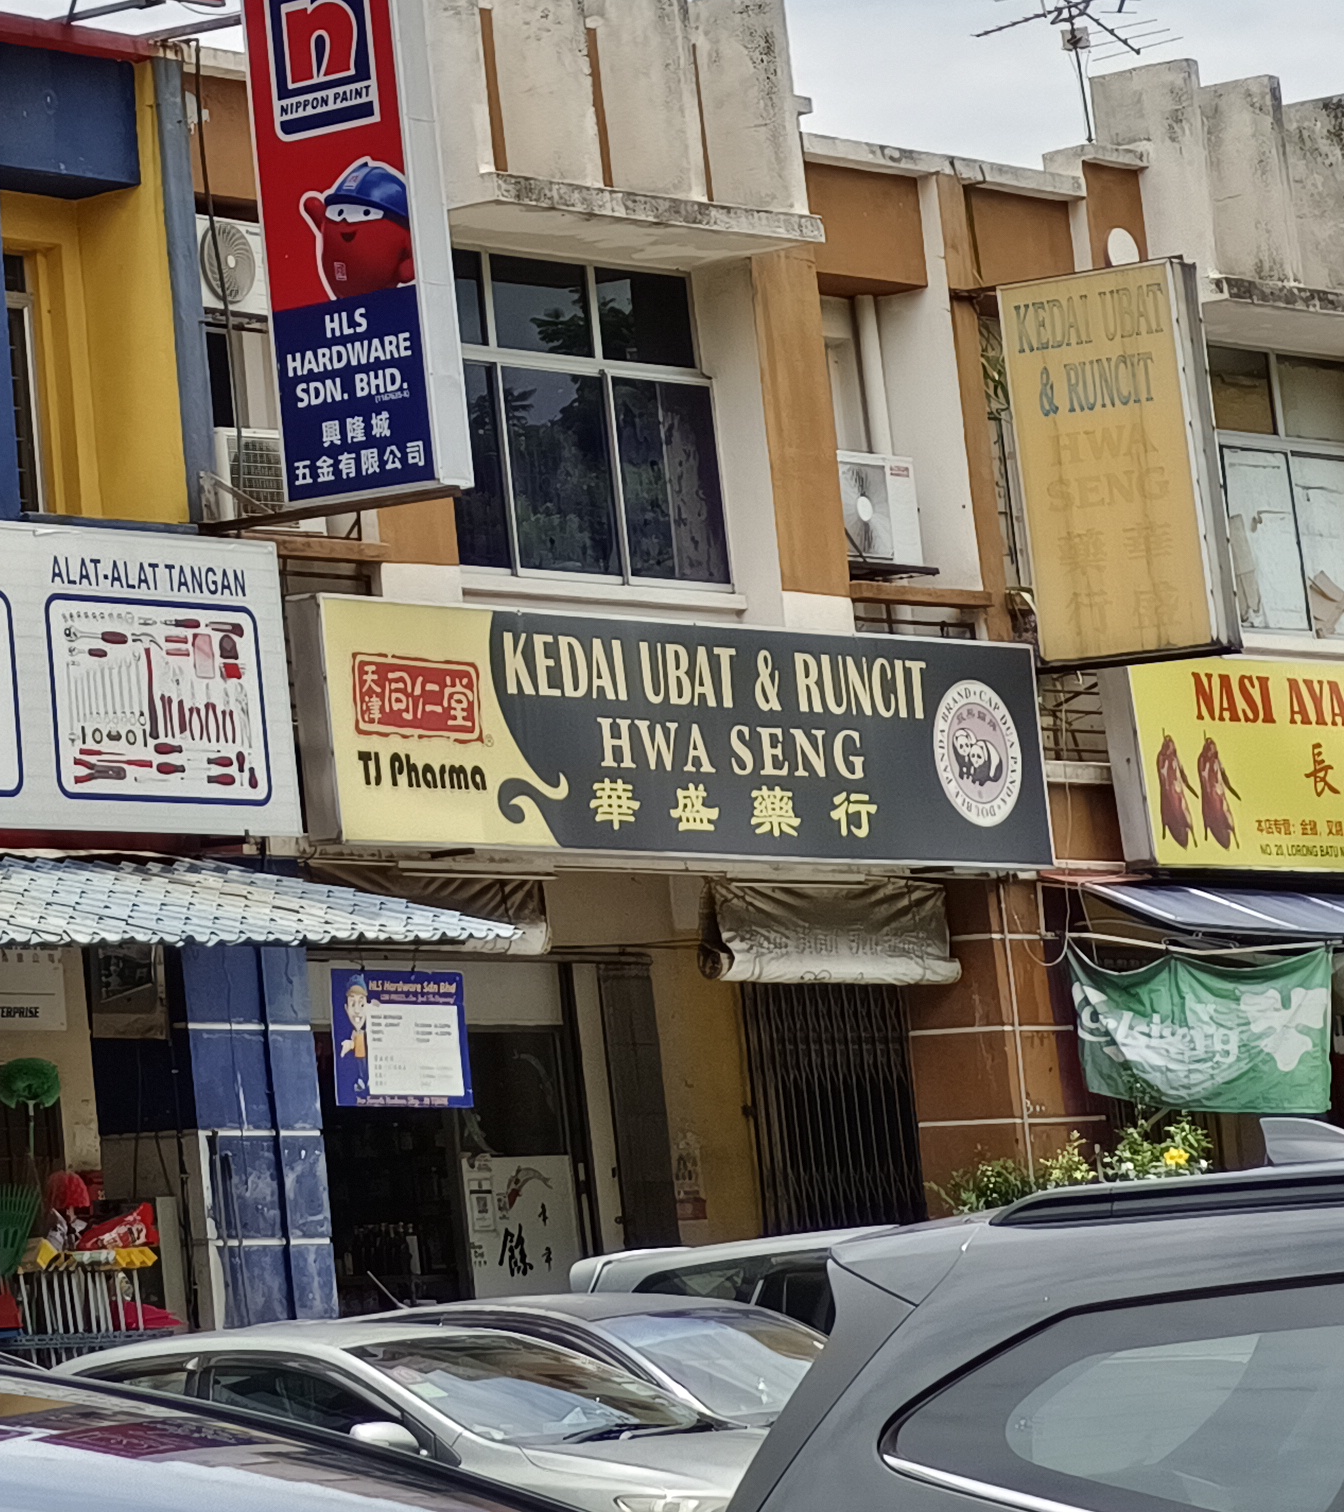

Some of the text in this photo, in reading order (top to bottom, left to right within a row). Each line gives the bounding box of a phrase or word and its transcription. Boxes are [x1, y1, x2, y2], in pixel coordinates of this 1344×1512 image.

[280, 85, 372, 118] NIPPON PAINT
[325, 307, 368, 338] HLS
[1014, 282, 1164, 354] KEDAI UBAT
[286, 332, 412, 377] HARDWARE
[296, 367, 408, 408] SDN. BHD.
[1039, 351, 1154, 417] & RUNCIT
[322, 411, 390, 447] 興隆城
[1051, 422, 1159, 467] HWA
[294, 440, 425, 485] 五金有限公司
[1047, 466, 1170, 512] SENG
[51, 555, 247, 598] ALAT-ALAT TANGAN
[503, 630, 927, 720] KEDAI UBAT & RUNCIT
[1191, 671, 1276, 723] NASI
[385, 671, 473, 726] 同仁堂
[358, 750, 487, 791] TJ Pharma
[599, 717, 866, 780] HWA SENG
[589, 778, 878, 839] 華盛藥行
